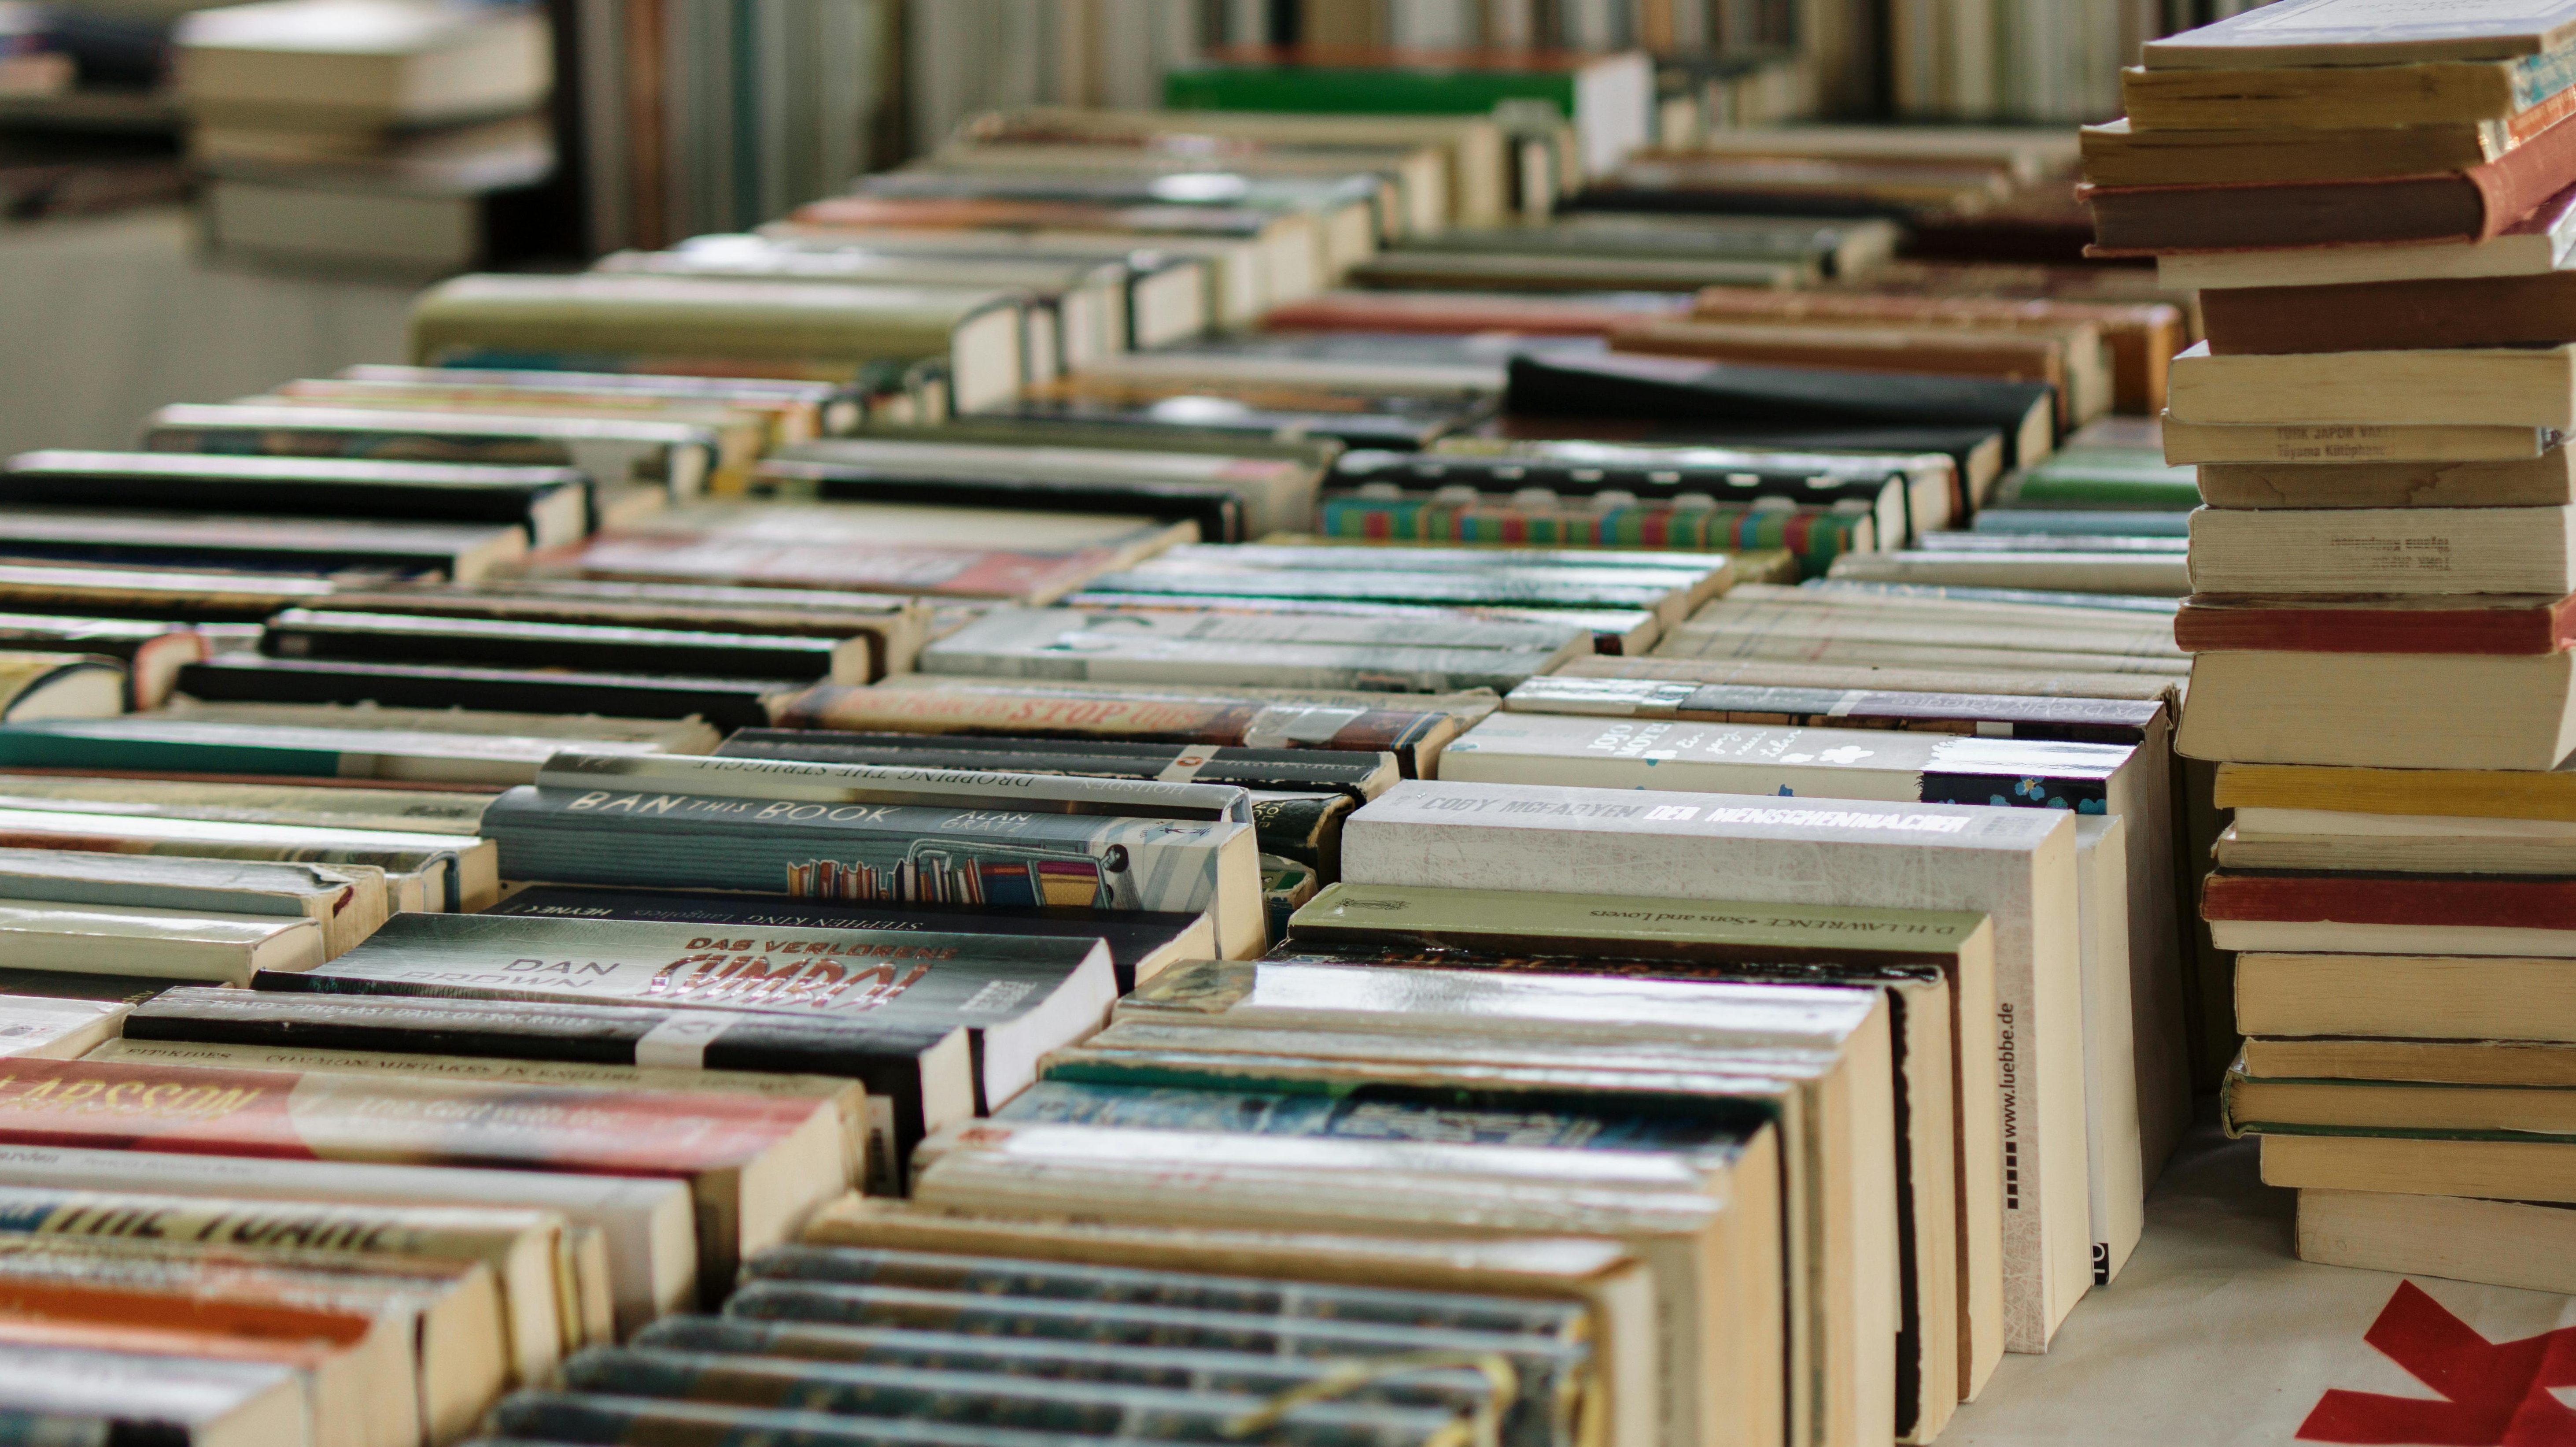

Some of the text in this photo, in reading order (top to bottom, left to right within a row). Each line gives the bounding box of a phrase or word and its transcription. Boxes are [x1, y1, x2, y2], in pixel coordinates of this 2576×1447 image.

[1005, 699, 1130, 725] STOP
[1587, 724, 1632, 751] JOJO
[693, 761, 1034, 787] DROPPING THE STRUGGLE
[1077, 780, 1188, 796] HOUSDEN
[565, 791, 902, 822] BAN THIS BOOK
[940, 818, 1030, 832] GRATZ
[956, 810, 1033, 822] ALAN
[1642, 805, 1701, 821] DER
[1705, 807, 1971, 833] MENSCHENMACHER
[743, 914, 923, 930] STEPHEN KING
[1589, 910, 1653, 921] Lovers
[1655, 913, 1695, 922] and
[1700, 915, 1745, 925] Sons
[1762, 918, 1897, 933] LAWRENCE
[683, 937, 959, 961] DAS VERLORENE
[501, 958, 620, 976] DAN
[398, 970, 593, 988] BROWN
[395, 1009, 447, 1018] DAYS
[266, 1054, 369, 1066] COMMON
[379, 1060, 490, 1072] MISTAKES
[1998, 1002, 2017, 1138] www.luebbe.de
